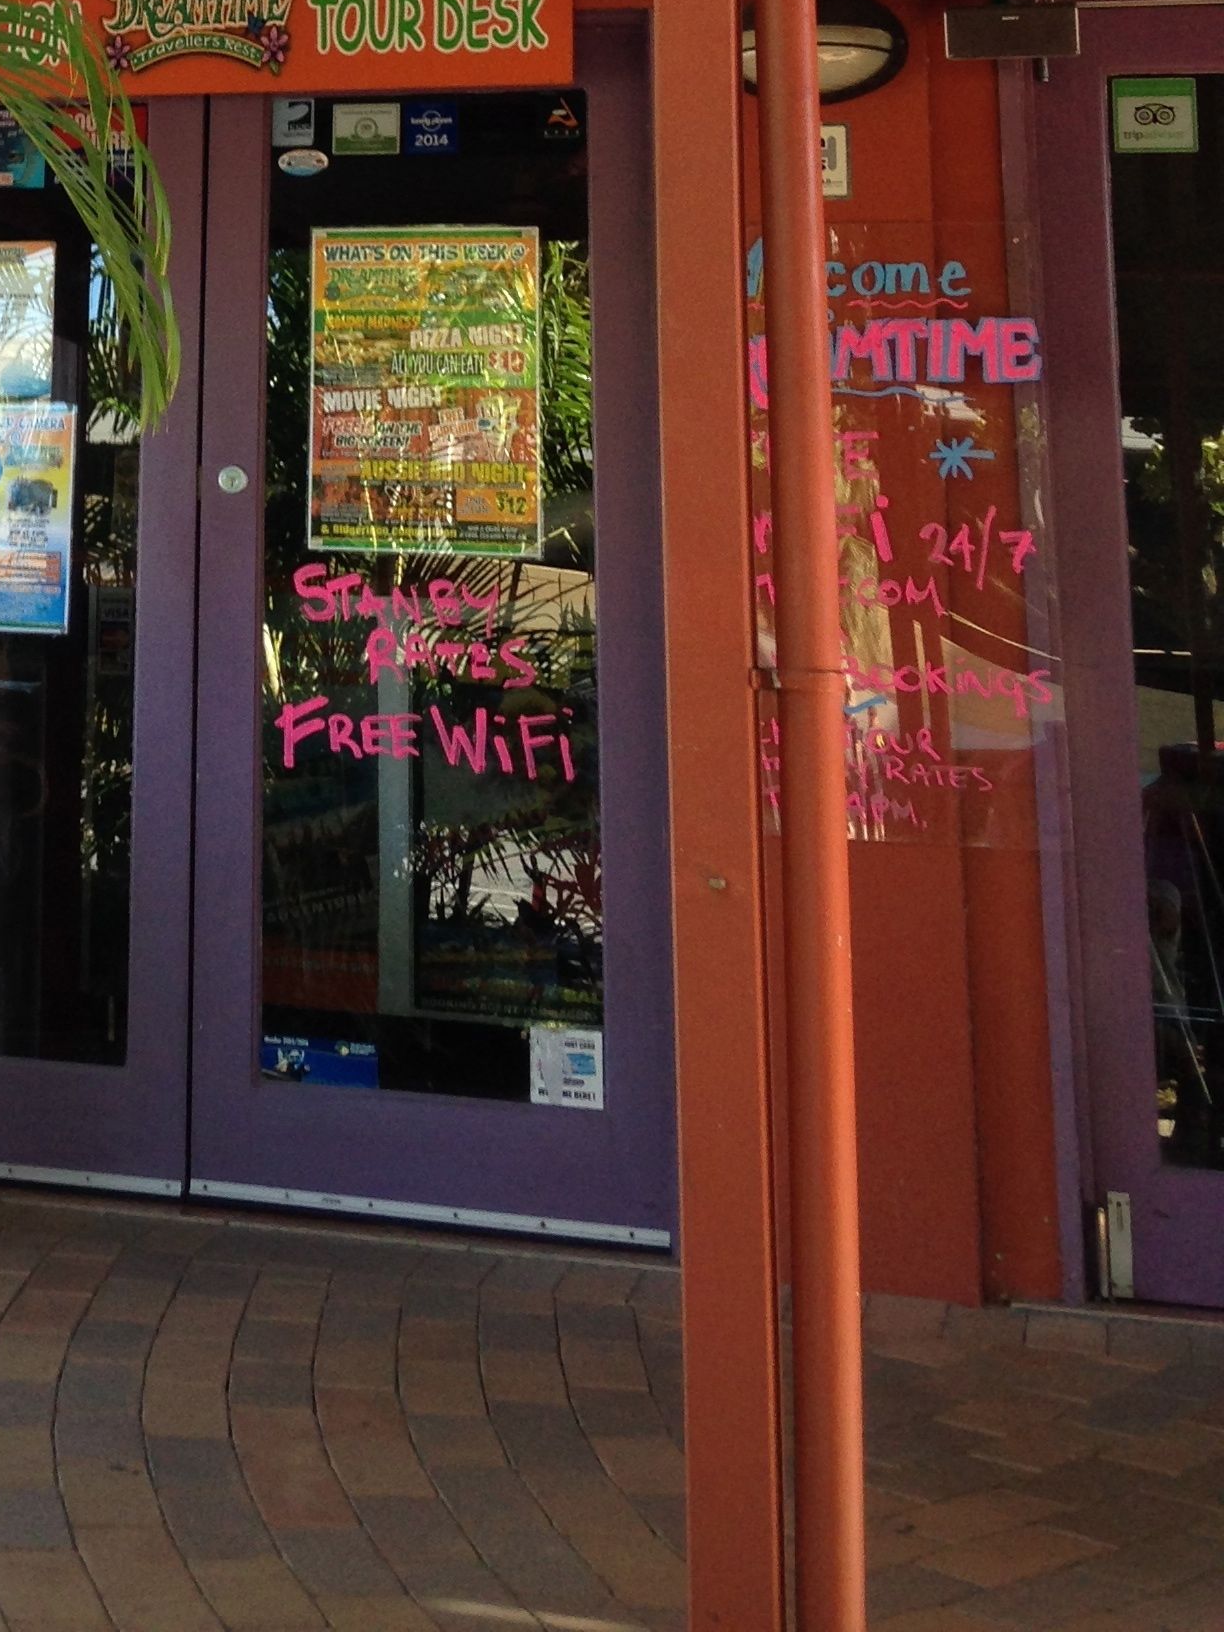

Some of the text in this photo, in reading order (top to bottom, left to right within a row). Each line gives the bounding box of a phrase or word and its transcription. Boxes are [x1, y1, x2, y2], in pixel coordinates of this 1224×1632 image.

[136, 35, 256, 63] Travellers Rest
[414, 133, 449, 147] 2014
[324, 242, 386, 263] WHAT'S
[389, 243, 412, 262] ON
[418, 243, 459, 262] THIS
[463, 242, 507, 262] WEEK
[410, 324, 525, 349] PIZZA NIGHT
[411, 353, 433, 375] YOU
[435, 353, 458, 376] CAN
[323, 386, 442, 413] MOVIE NIGHT
[336, 435, 355, 448] BIG
[359, 459, 423, 481] AUSSIE
[471, 462, 527, 483] NIGHT
[919, 505, 1037, 591] 24/7
[293, 563, 500, 638] STANBY
[364, 628, 537, 689] RATES
[274, 695, 576, 783] FREE WiFi
[867, 728, 942, 762] OUR
[885, 757, 993, 792] RATES
